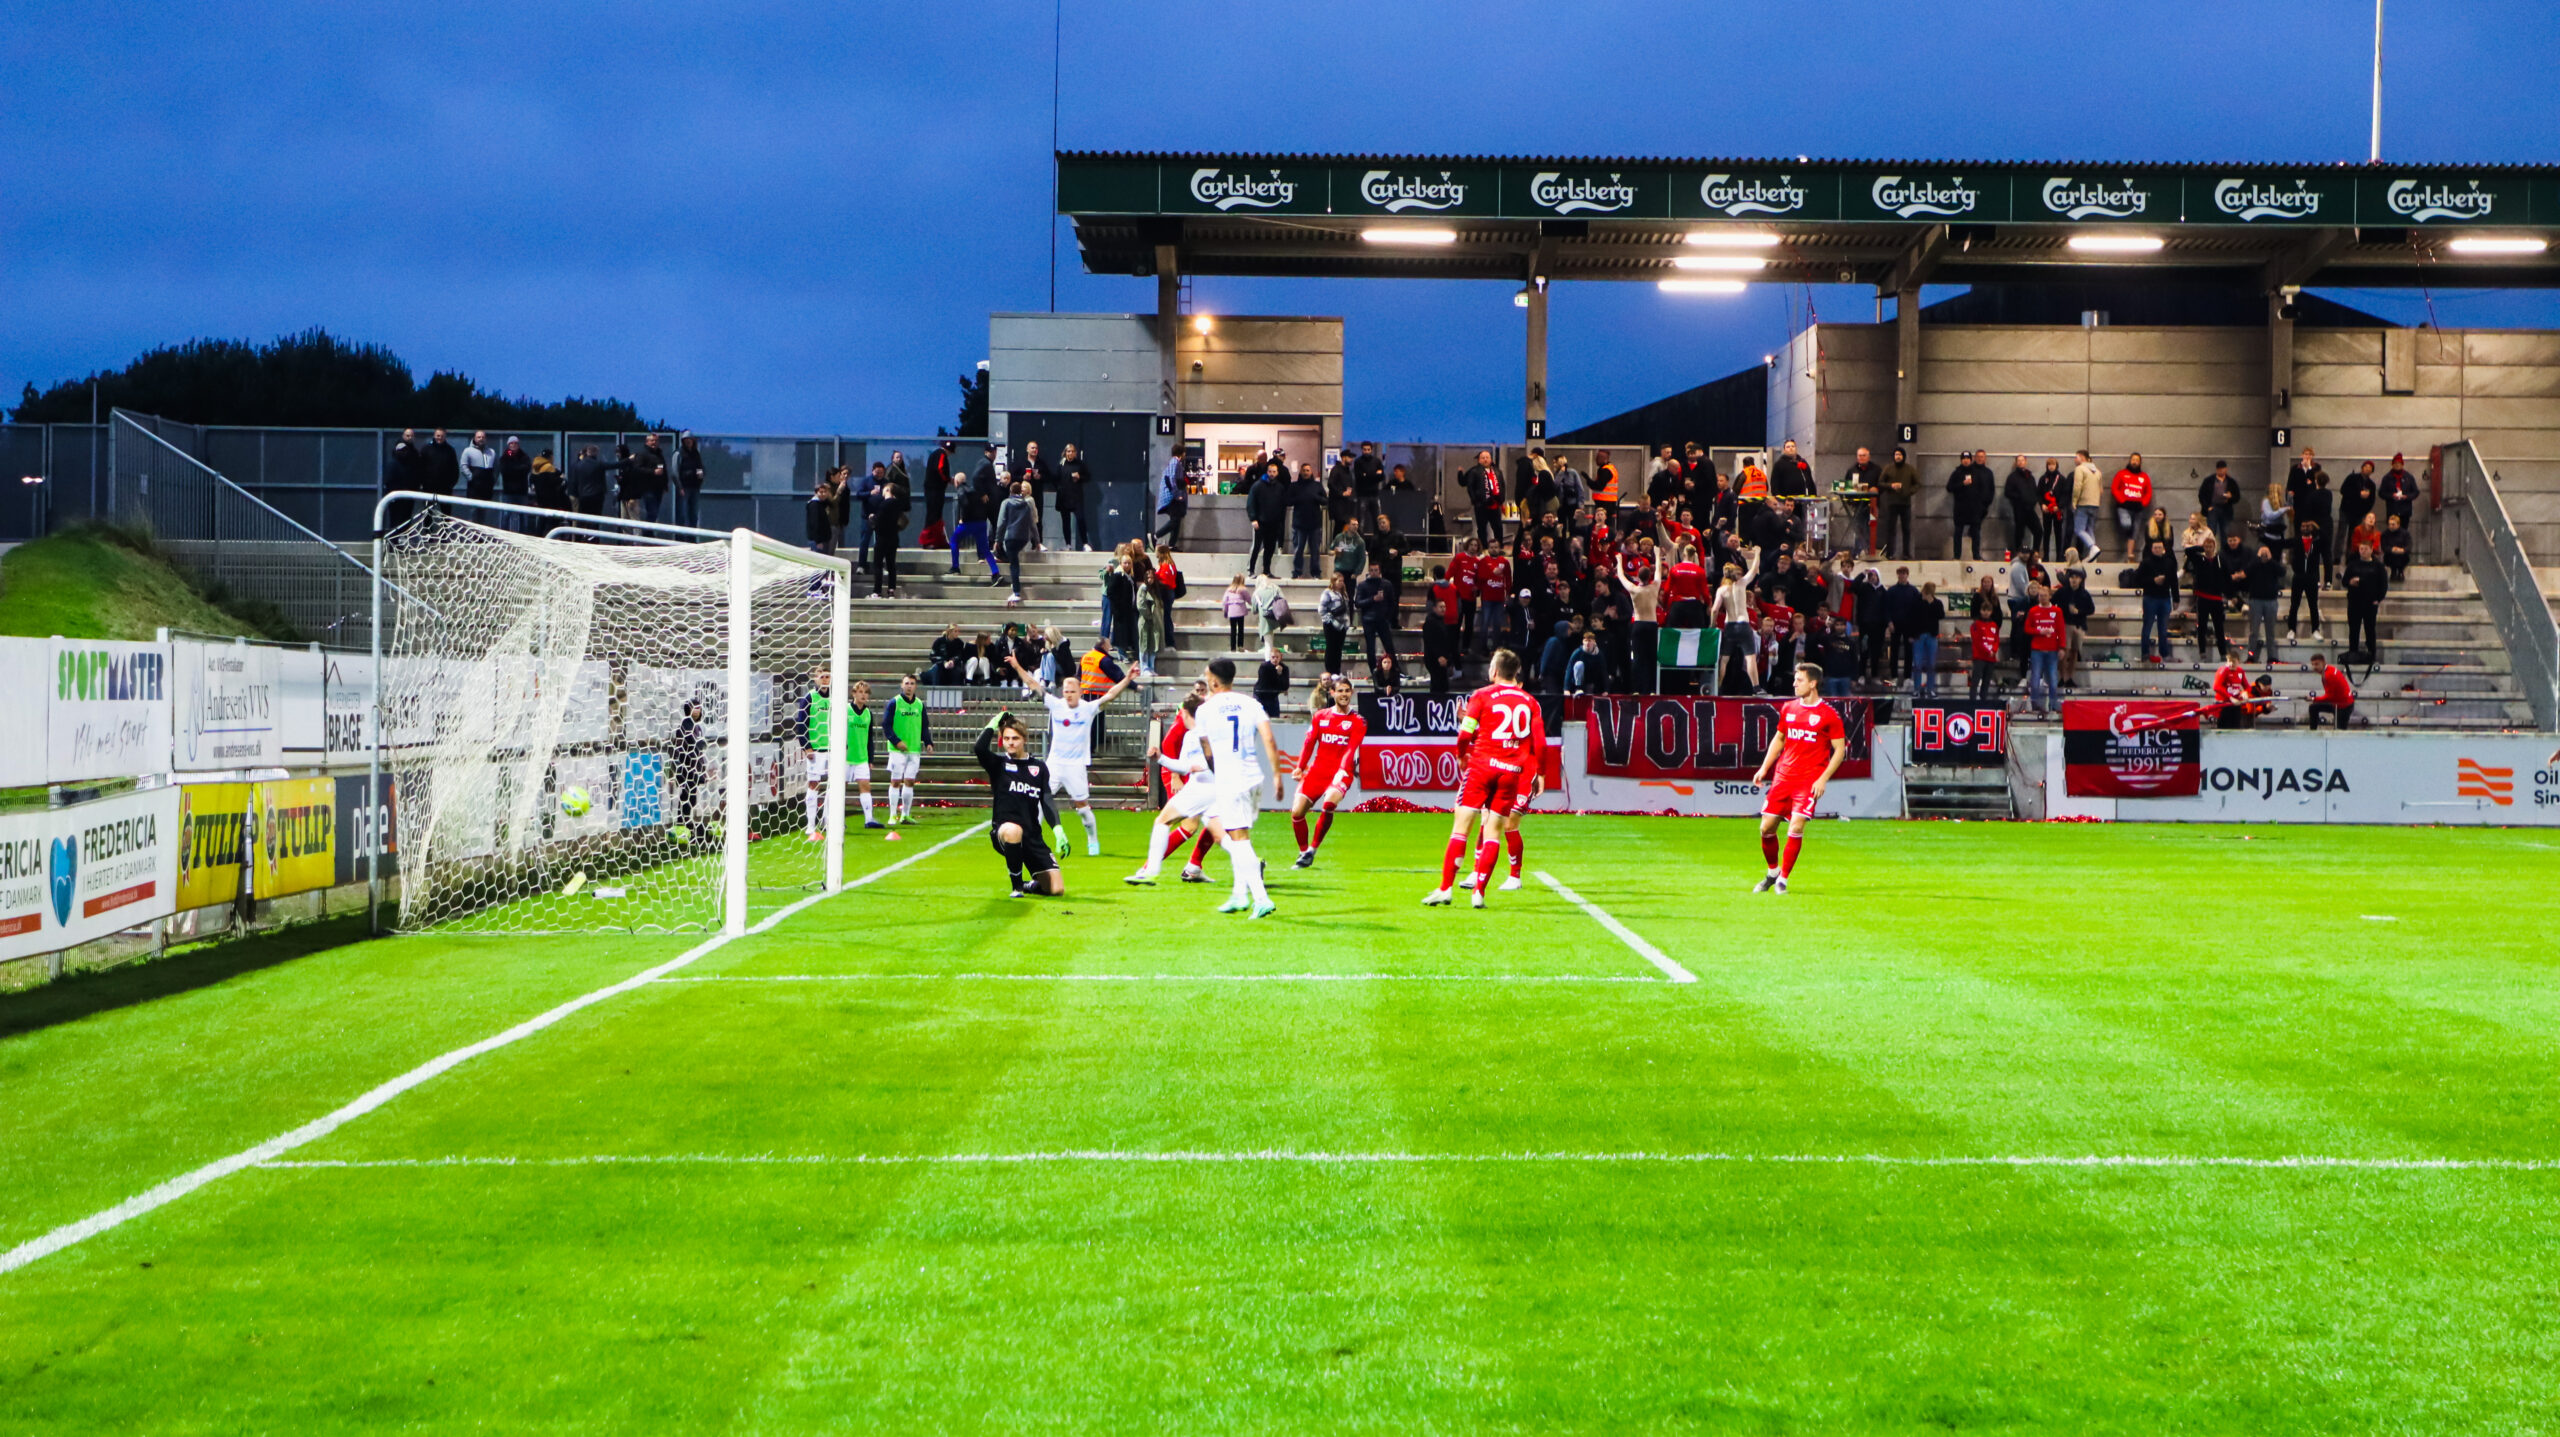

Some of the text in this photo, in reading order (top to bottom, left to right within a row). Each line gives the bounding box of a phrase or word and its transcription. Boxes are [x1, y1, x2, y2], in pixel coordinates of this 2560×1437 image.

[1191, 169, 1294, 210] Carlsberg
[1361, 171, 1464, 212] Carlsberg
[1531, 173, 1634, 214] Carlsberg
[1701, 175, 1804, 216] Carlsberg
[1873, 176, 1976, 217] Carlsberg
[2043, 178, 2146, 219] Carlsberg
[2215, 179, 2318, 220] Carlsberg
[2387, 180, 2490, 221] Carlsberg
[1162, 418, 1170, 433] H
[1532, 422, 1540, 437] H
[1904, 426, 1911, 441] G
[2277, 430, 2285, 445] G
[58, 649, 164, 701] SPORTMASTER
[249, 685, 269, 719] VVS
[328, 713, 361, 752] BRAGE
[1227, 715, 1239, 753] 7
[1491, 703, 1532, 740] 20
[1592, 697, 1870, 769] VOLDM
[2143, 728, 2171, 747] FC
[2117, 747, 2171, 756] FREDERICIA
[2126, 757, 2161, 773] 1991
[1714, 780, 1760, 796] Since
[2534, 769, 2559, 785] Oil
[83, 813, 157, 865] FREDERICIA
[279, 804, 332, 859] TULIP
[6, 885, 43, 910] DANMARK
